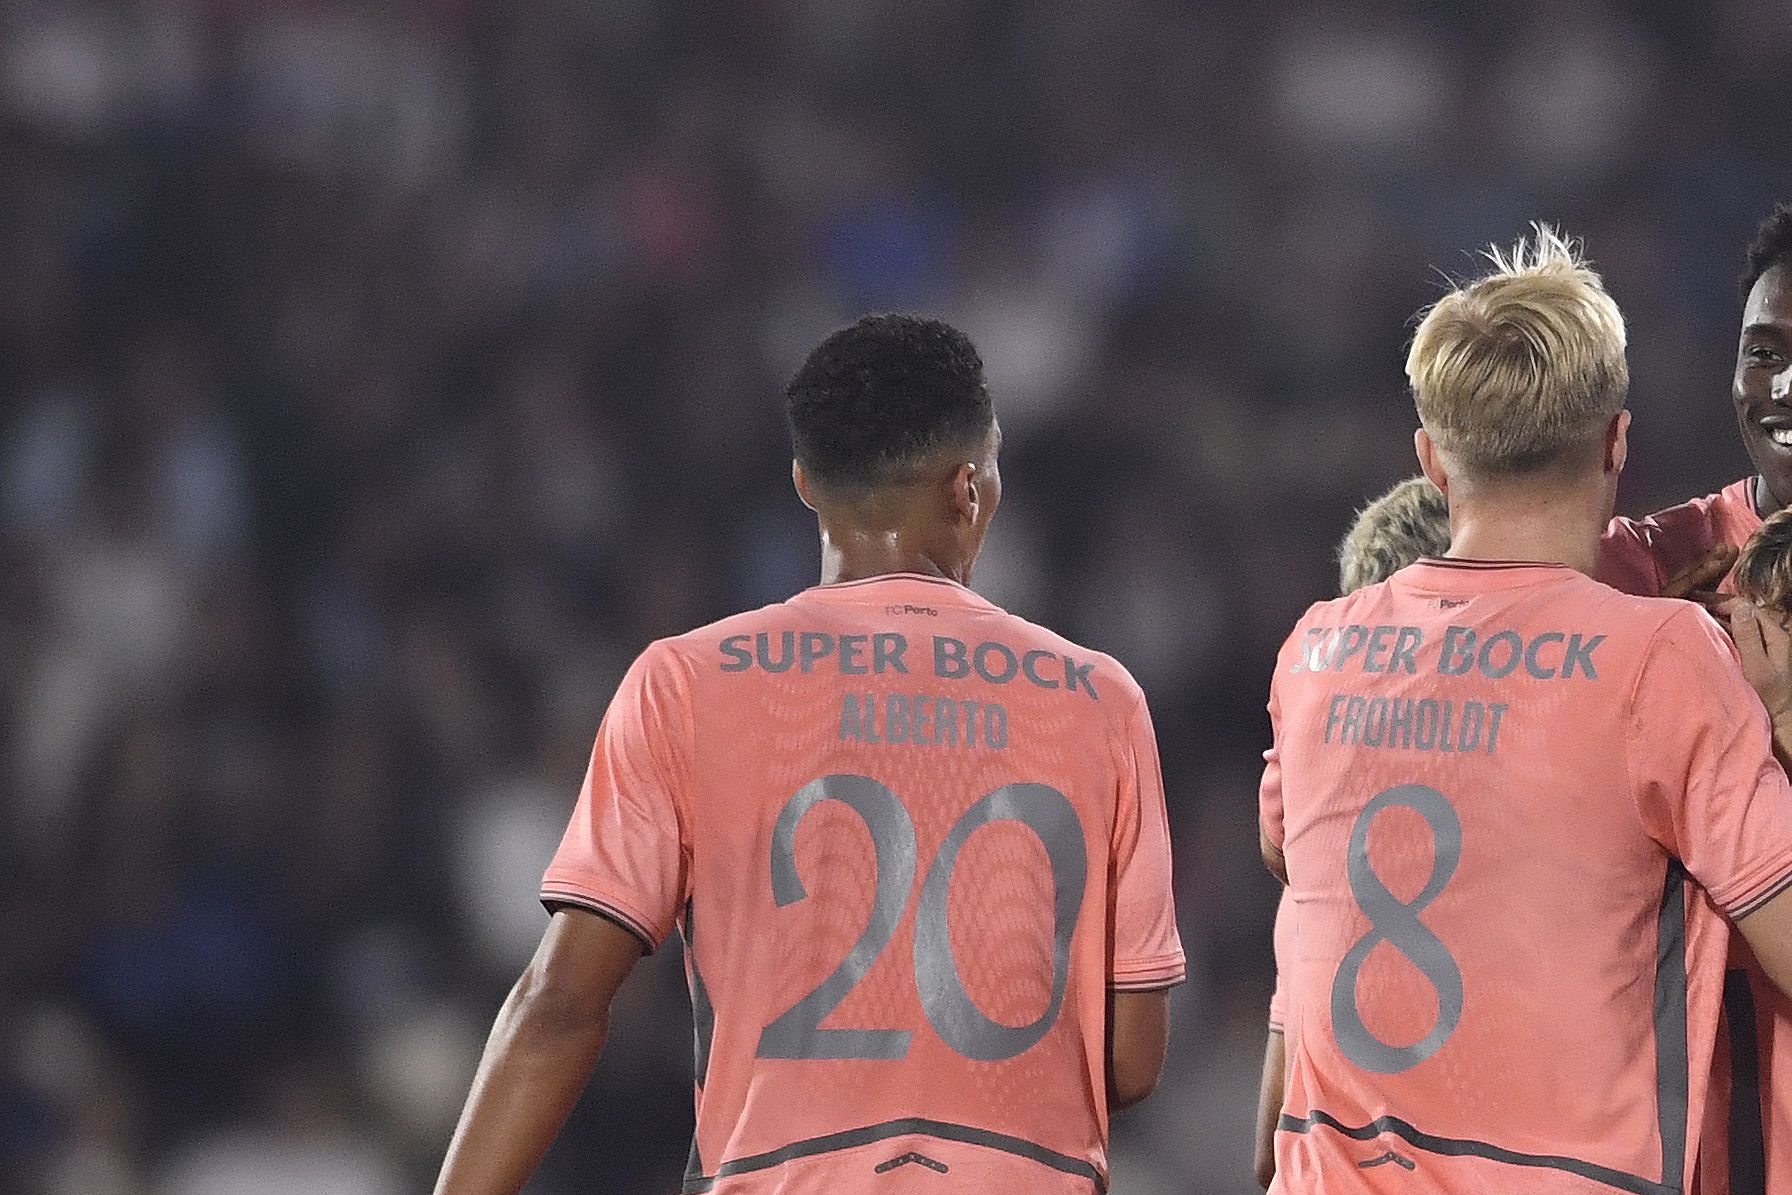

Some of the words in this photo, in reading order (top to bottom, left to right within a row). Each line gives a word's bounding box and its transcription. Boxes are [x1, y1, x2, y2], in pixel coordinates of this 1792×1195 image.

[904, 604, 939, 617] Porto
[718, 631, 909, 675] SUPER
[933, 634, 1100, 699] BOCK
[1290, 625, 1424, 674] SUPER
[1438, 626, 1607, 680] BOCK
[839, 693, 1008, 750] ALBERTO
[755, 774, 1088, 1061] 20
[1331, 784, 1464, 1074] 8
